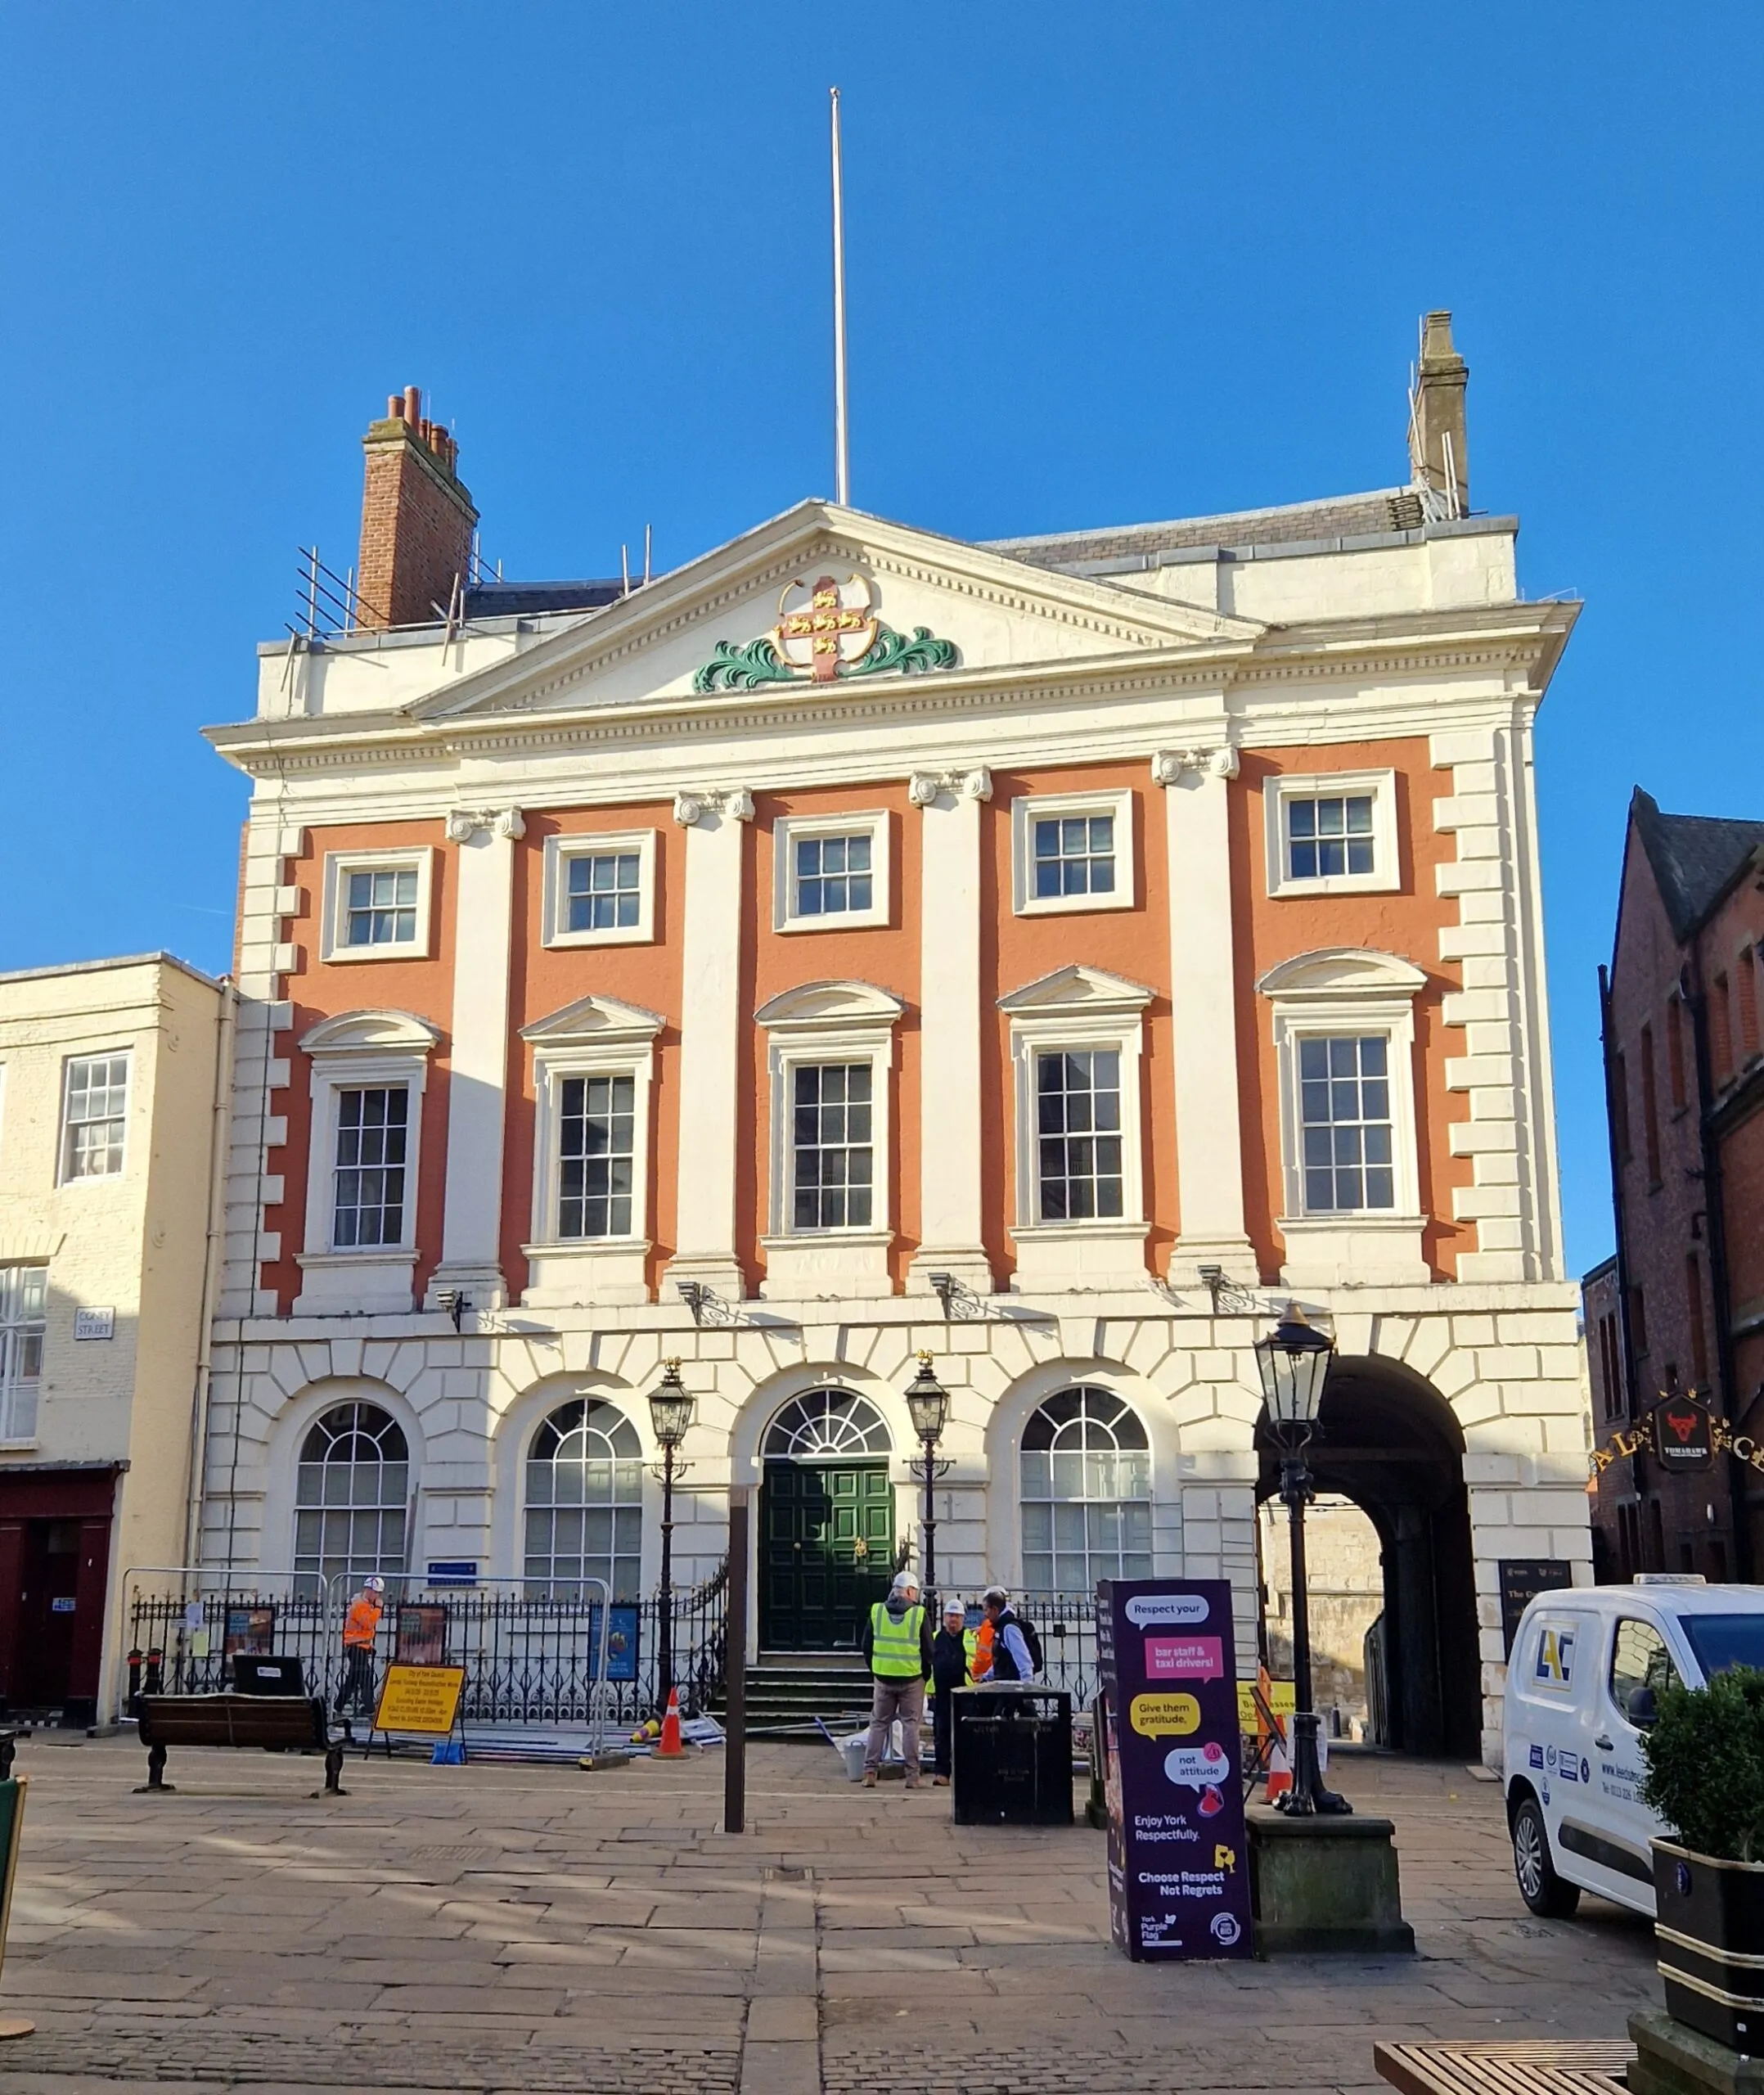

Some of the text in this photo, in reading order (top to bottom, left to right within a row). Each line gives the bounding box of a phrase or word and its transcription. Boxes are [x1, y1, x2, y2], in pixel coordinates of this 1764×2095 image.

[78, 1324, 110, 1335] STREET
[1663, 1447, 1708, 1455] TOMAHAWK
[1134, 1604, 1200, 1615] Respect your
[1155, 1646, 1204, 1657] bar staff &
[1155, 1657, 1213, 1668] taxi drivers!
[1139, 1703, 1190, 1712] Give them
[1140, 1714, 1187, 1726] gratitude,
[1135, 1814, 1186, 1827] Enjoy York
[1136, 1829, 1200, 1842] Respectfully.
[1138, 1871, 1225, 1884] Choose Respect
[1160, 1885, 1222, 1898] Not Regrets
[1141, 1922, 1168, 1931] Purple
[1141, 1931, 1159, 1940] Flag
